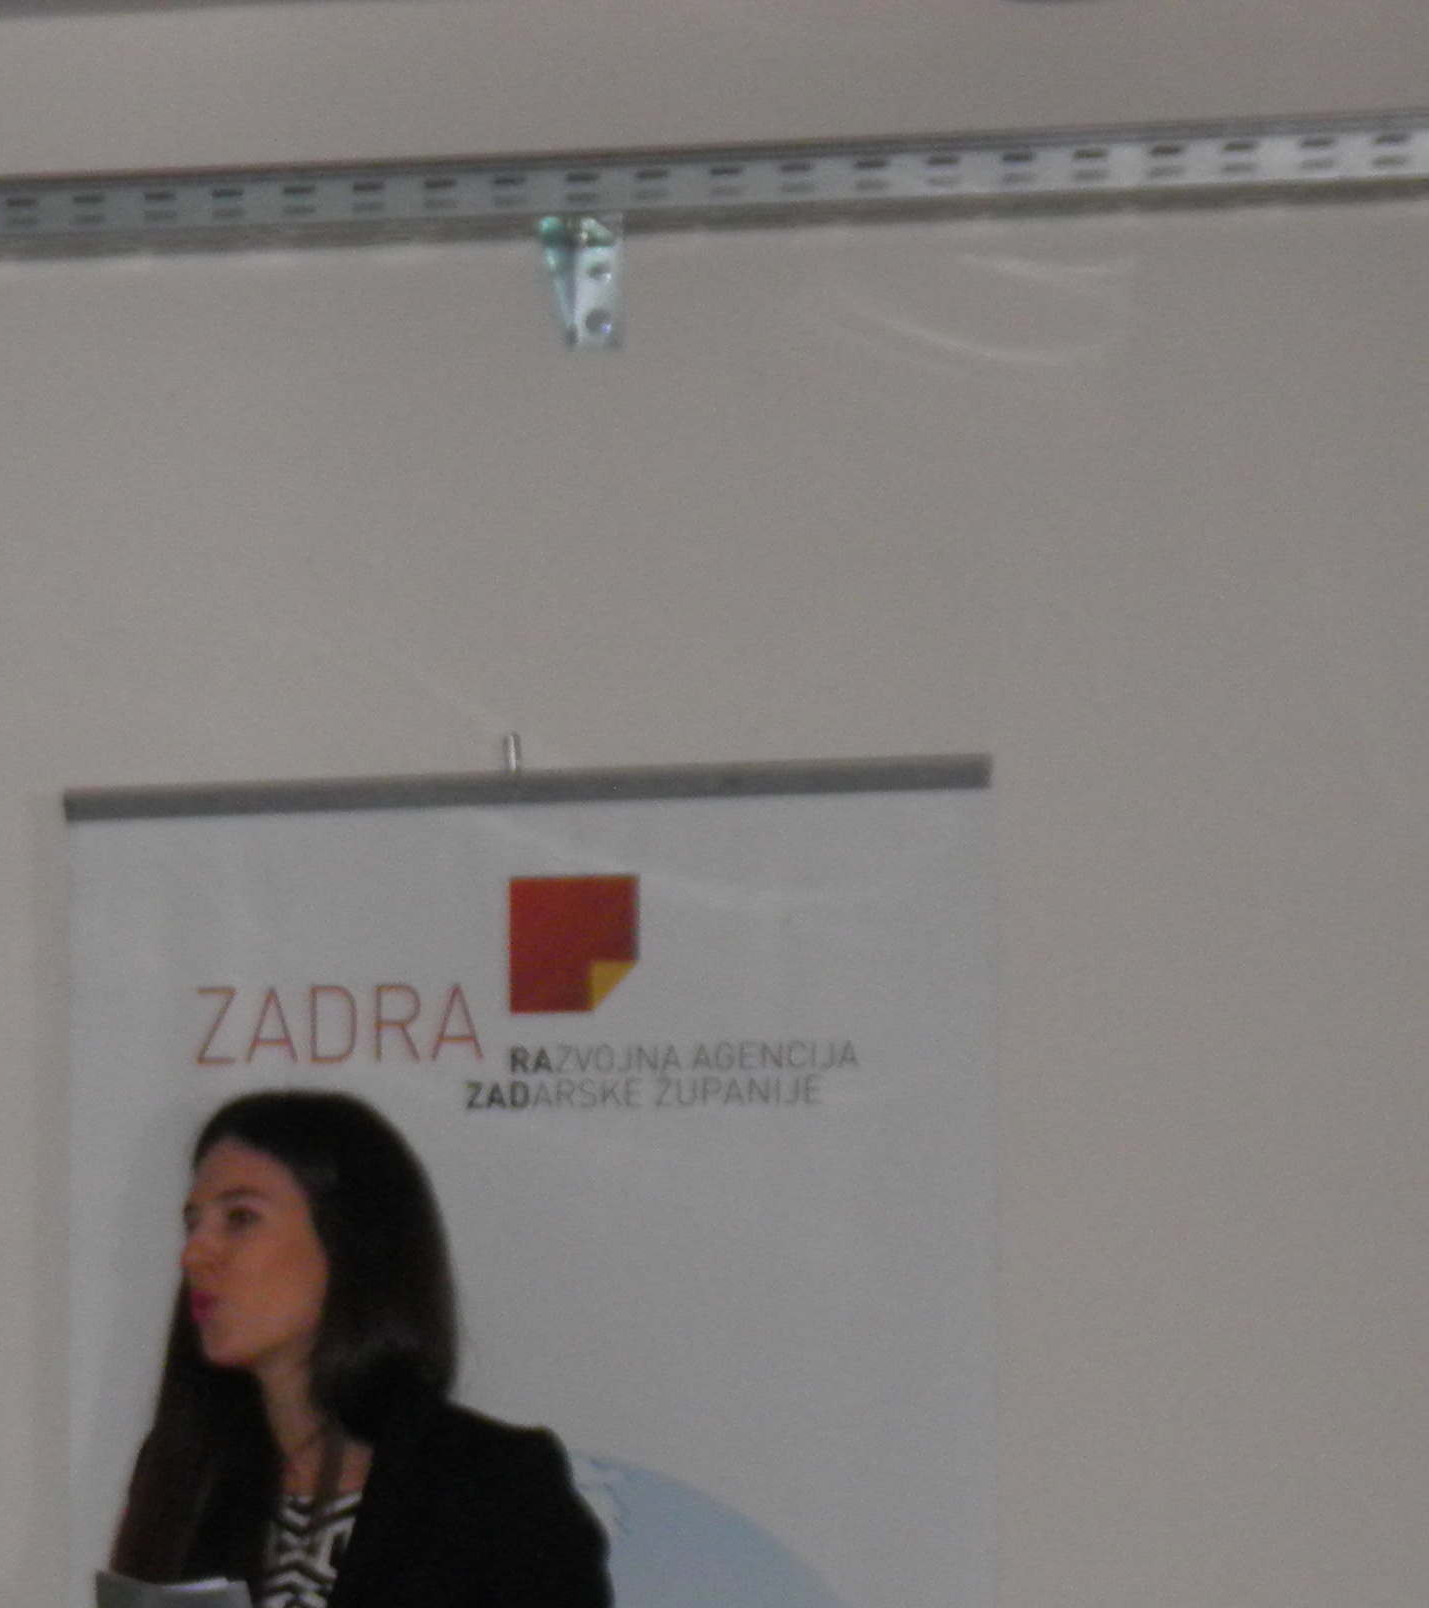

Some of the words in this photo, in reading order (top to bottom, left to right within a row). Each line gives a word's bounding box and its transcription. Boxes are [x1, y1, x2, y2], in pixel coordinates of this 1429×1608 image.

[195, 984, 484, 1067] ZADRA
[508, 1044, 681, 1075] RAZVOJNA
[692, 1039, 859, 1071] AGENCIJA
[464, 1076, 641, 1111] ZADARSKE
